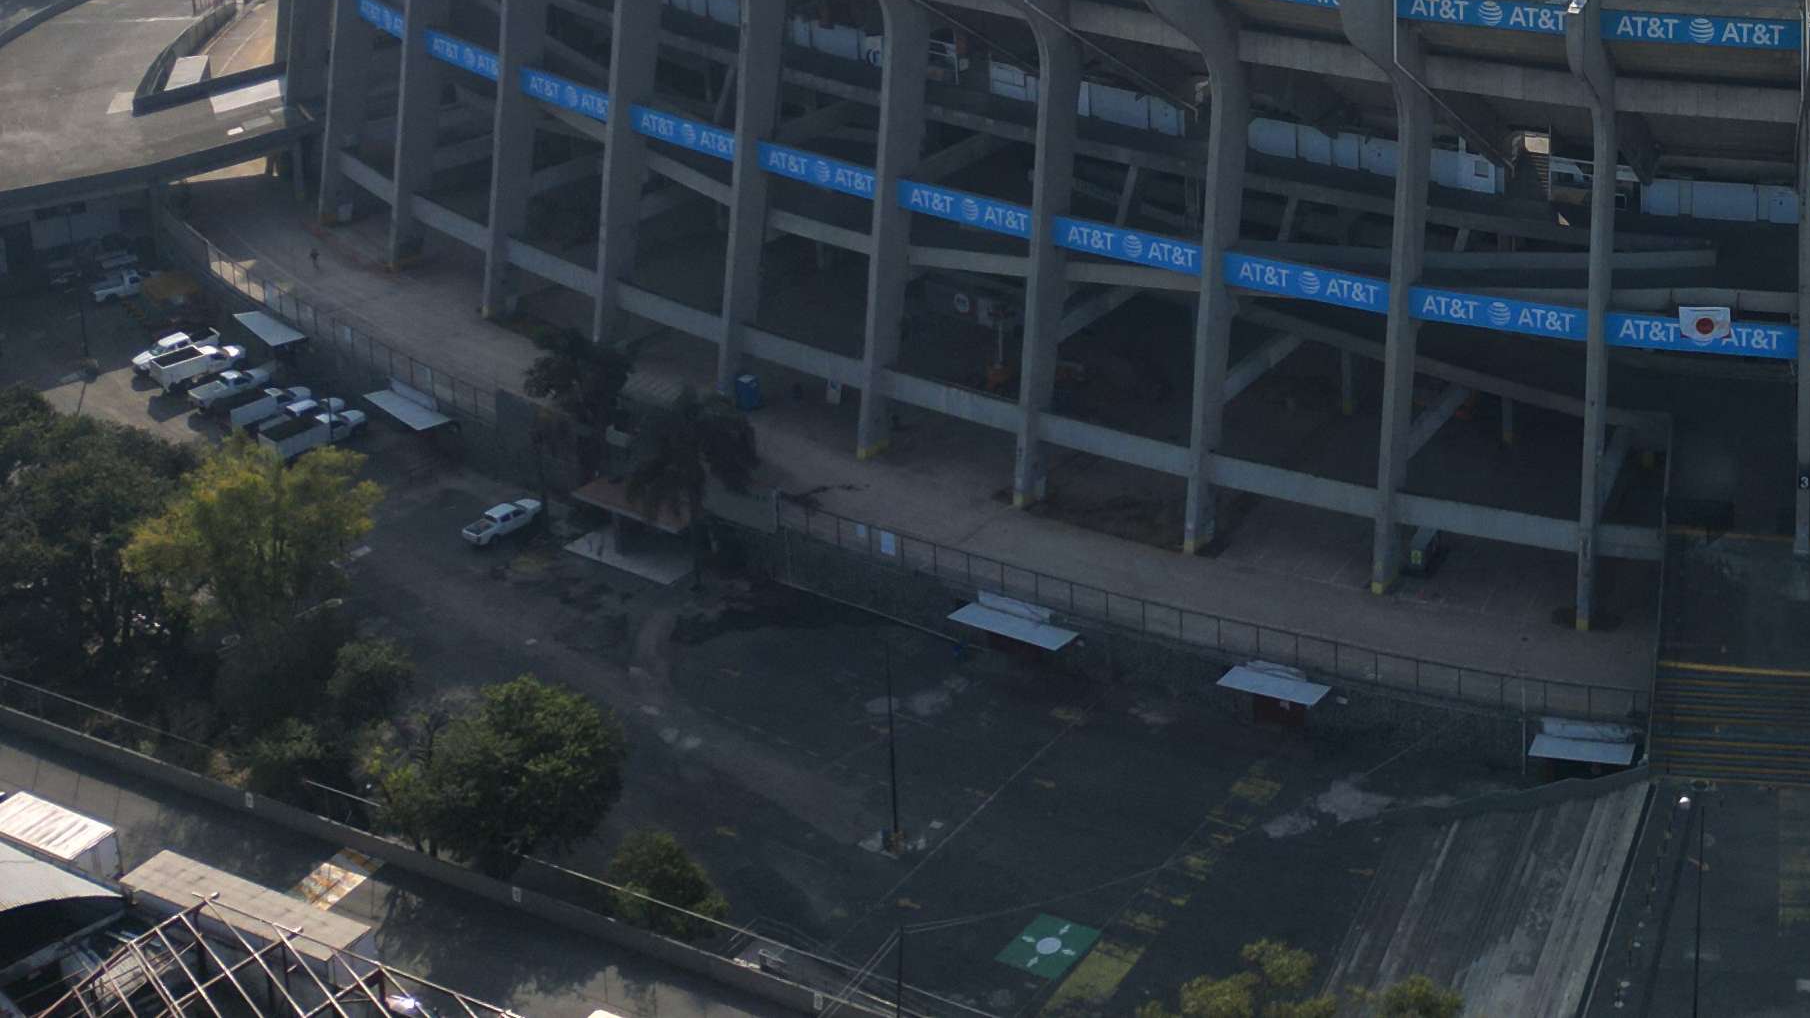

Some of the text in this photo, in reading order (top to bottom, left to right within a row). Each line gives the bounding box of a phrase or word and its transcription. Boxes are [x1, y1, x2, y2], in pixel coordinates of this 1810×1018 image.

[1510, 7, 1566, 30] AT&T
[1617, 16, 1785, 46] AT&T AT&T
[530, 76, 558, 98] AT&T
[641, 115, 735, 153] AT&T AT&T
[769, 151, 874, 192] AT&T AT&T
[911, 188, 1028, 231] AT&T AT&T
[1068, 226, 1197, 268] AT&T AT&T
[1239, 261, 1378, 304] AT&T AT&T
[1423, 295, 1575, 332] AT&T AT&T
[1619, 318, 1782, 350] AT&T AT&T
[1800, 476, 1809, 488] 3
